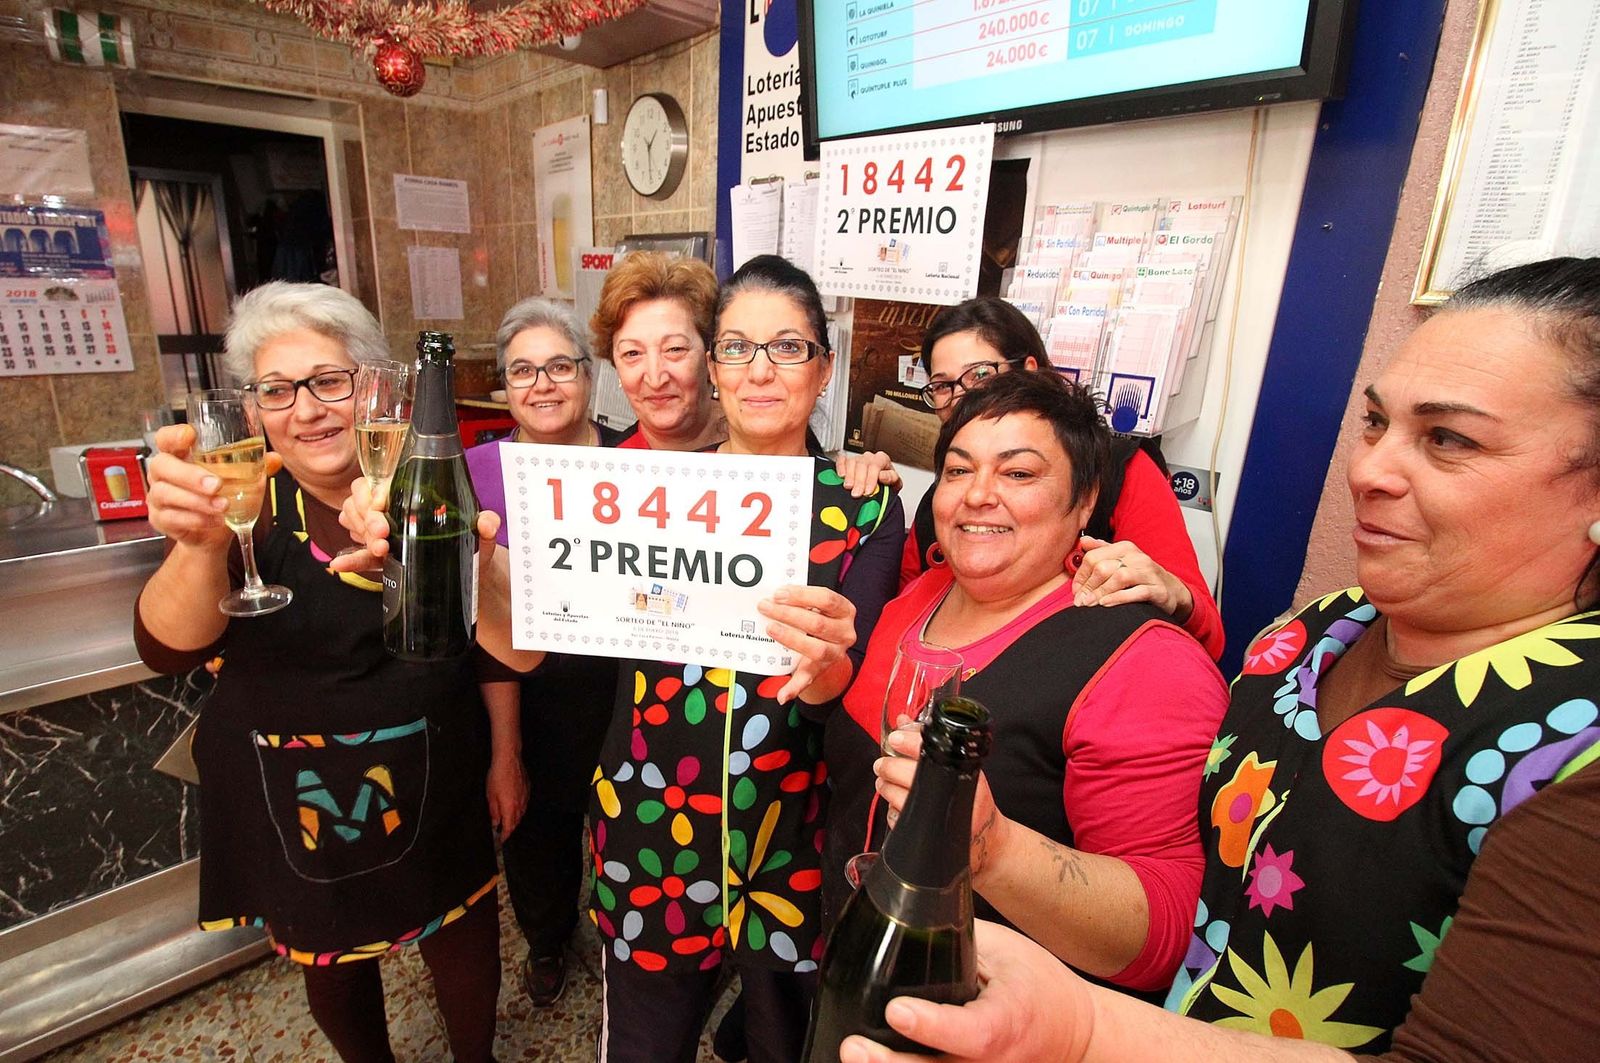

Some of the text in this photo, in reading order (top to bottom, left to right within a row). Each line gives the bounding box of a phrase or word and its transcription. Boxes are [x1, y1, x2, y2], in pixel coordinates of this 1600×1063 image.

[867, 2, 894, 14] QUINIELA
[859, 30, 887, 43] LOTOTURF
[1076, 16, 1184, 50] 07 DOMINGO
[893, 78, 907, 87] PLUS
[745, 126, 800, 154] Estado
[841, 154, 966, 196] 18442
[1188, 202, 1226, 210] Lototurf
[858, 206, 957, 235] PREMIO
[1169, 235, 1213, 244] El Gordo
[6, 290, 37, 298] 2018
[1068, 306, 1080, 315] Con
[1174, 477, 1195, 489] +18
[547, 478, 773, 538] 18442
[590, 539, 763, 588] PREMIO
[746, 634, 775, 643] Nacional
